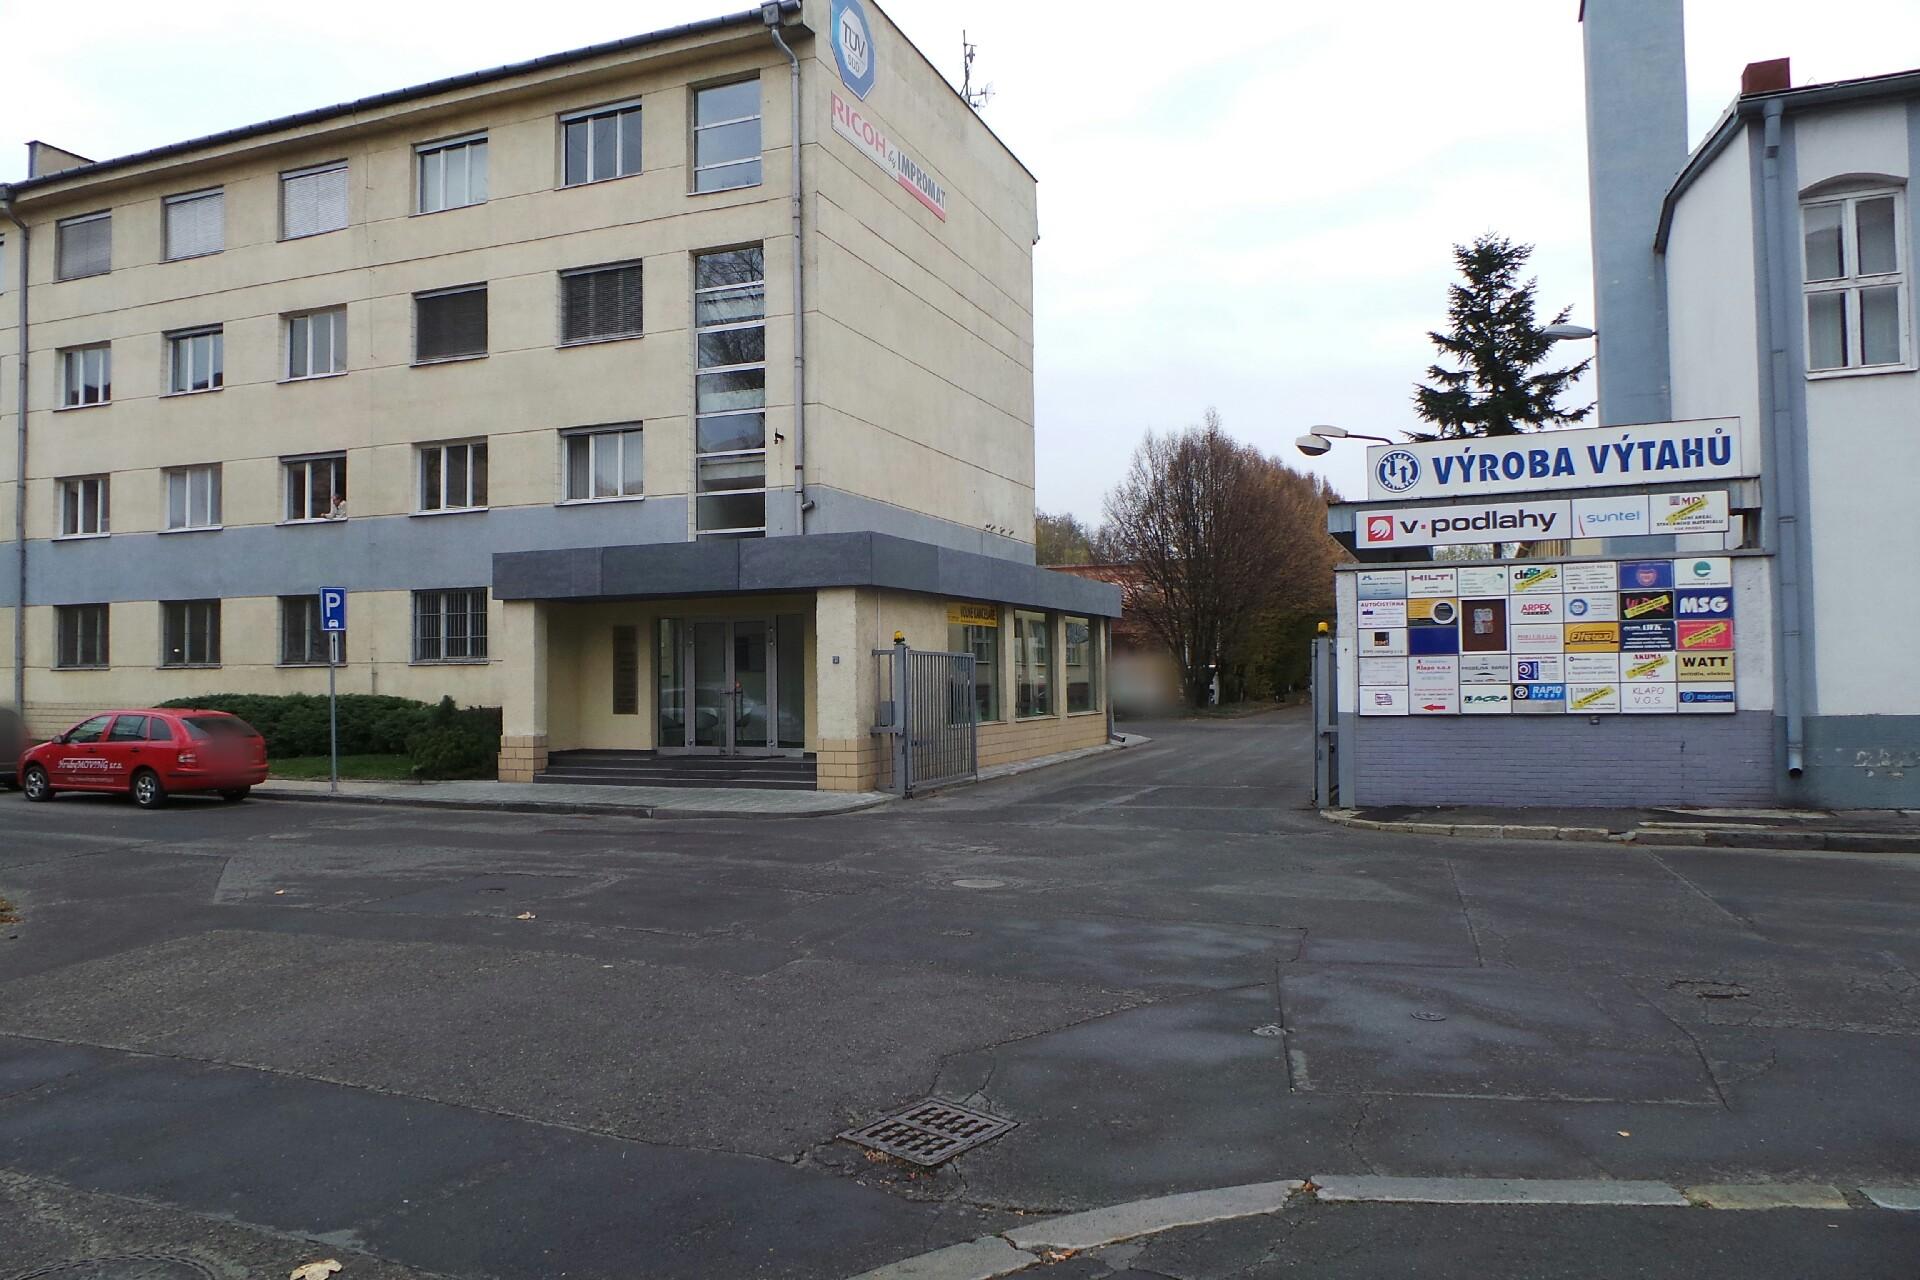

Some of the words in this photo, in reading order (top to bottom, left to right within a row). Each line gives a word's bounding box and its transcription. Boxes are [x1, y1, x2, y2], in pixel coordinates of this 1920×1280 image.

[843, 20, 866, 59] TÜV
[832, 97, 887, 158] RICOH
[898, 151, 946, 209] IMPROMAT
[1431, 446, 1576, 485] VÝROBA
[1586, 427, 1732, 474] VÝTAHŮ
[1586, 510, 1640, 524] suntel
[1411, 573, 1453, 581] HILTI
[325, 592, 341, 618] P
[1521, 603, 1552, 613] ARPEX
[1679, 596, 1729, 613] MSG
[1682, 656, 1729, 667] WATT
[1532, 685, 1562, 694] RAPID
[1632, 686, 1664, 694] KLAPO
